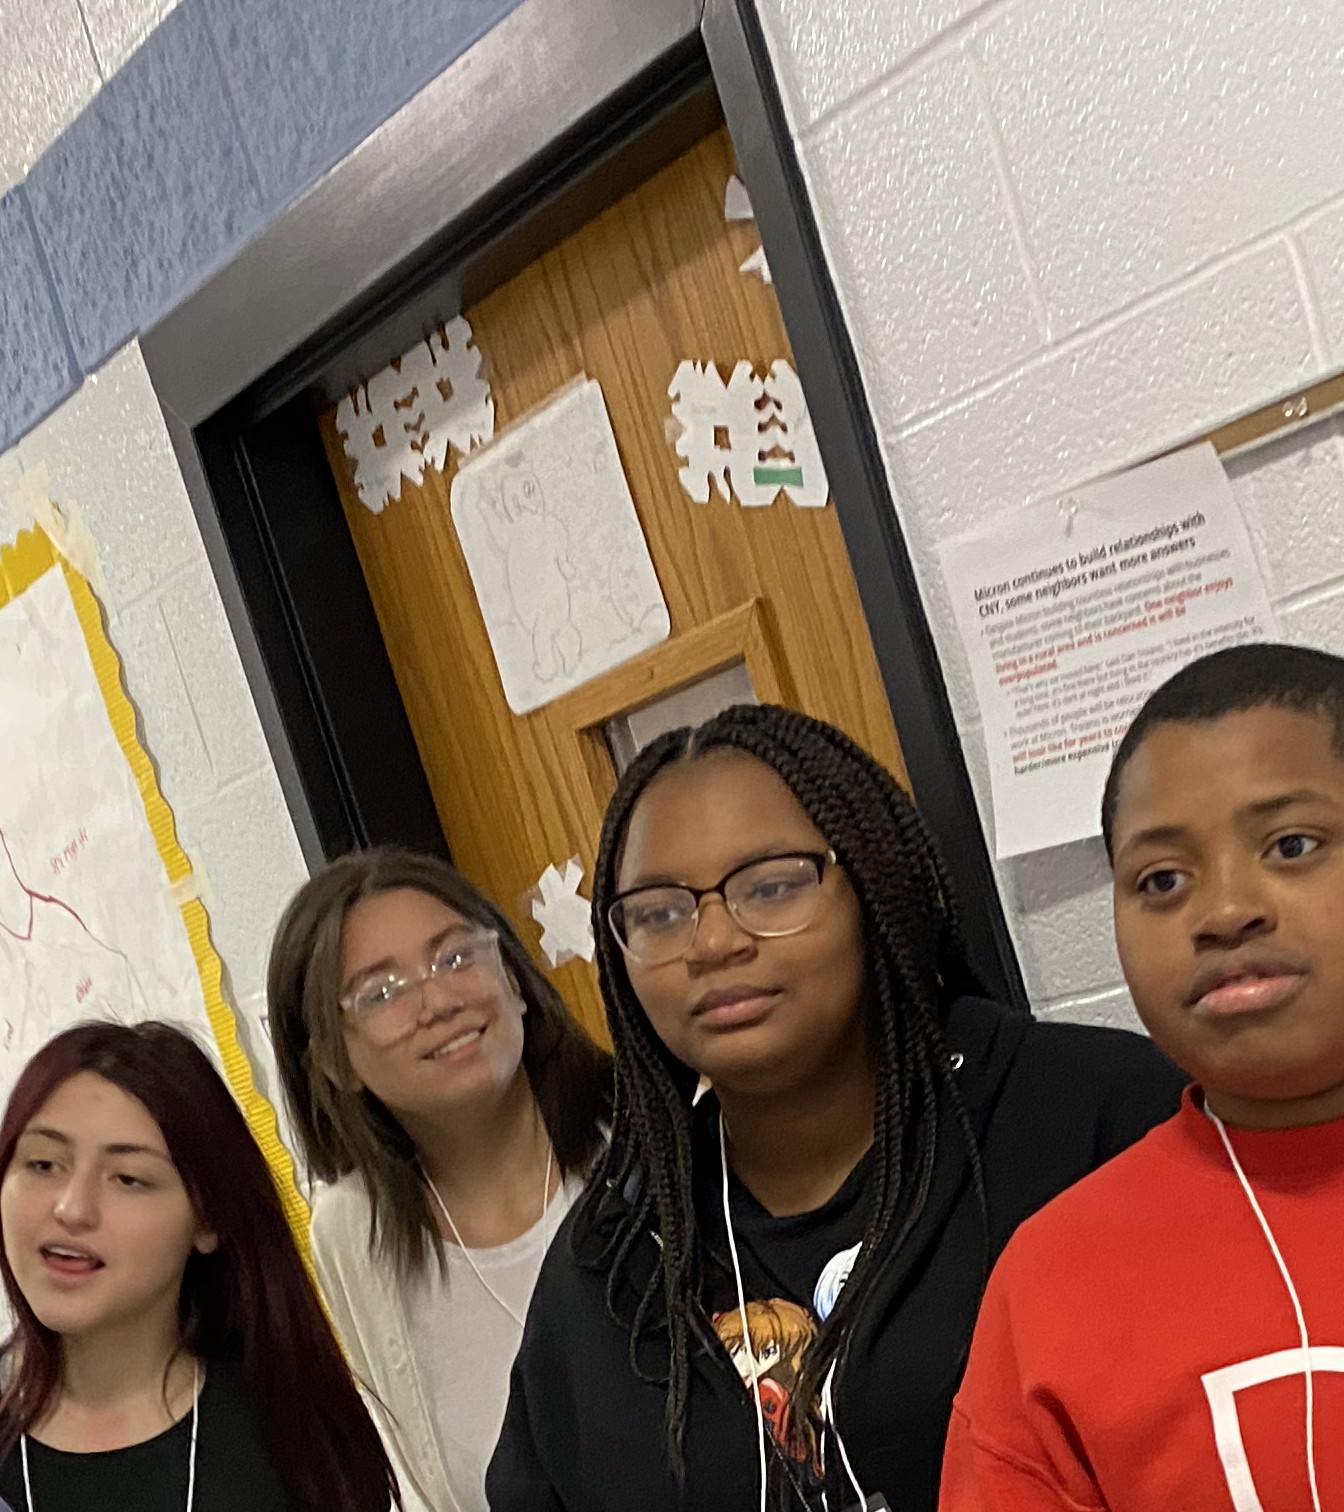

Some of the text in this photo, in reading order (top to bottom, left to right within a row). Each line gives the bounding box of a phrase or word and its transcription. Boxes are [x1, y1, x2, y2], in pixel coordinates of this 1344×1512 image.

[974, 512, 1206, 602] Micron continues to build relationships with
[1005, 592, 1032, 610] some
[1035, 572, 1088, 600] neighbors
[1089, 561, 1117, 581] want
[1119, 553, 1148, 571] more
[1150, 537, 1196, 561] answers
